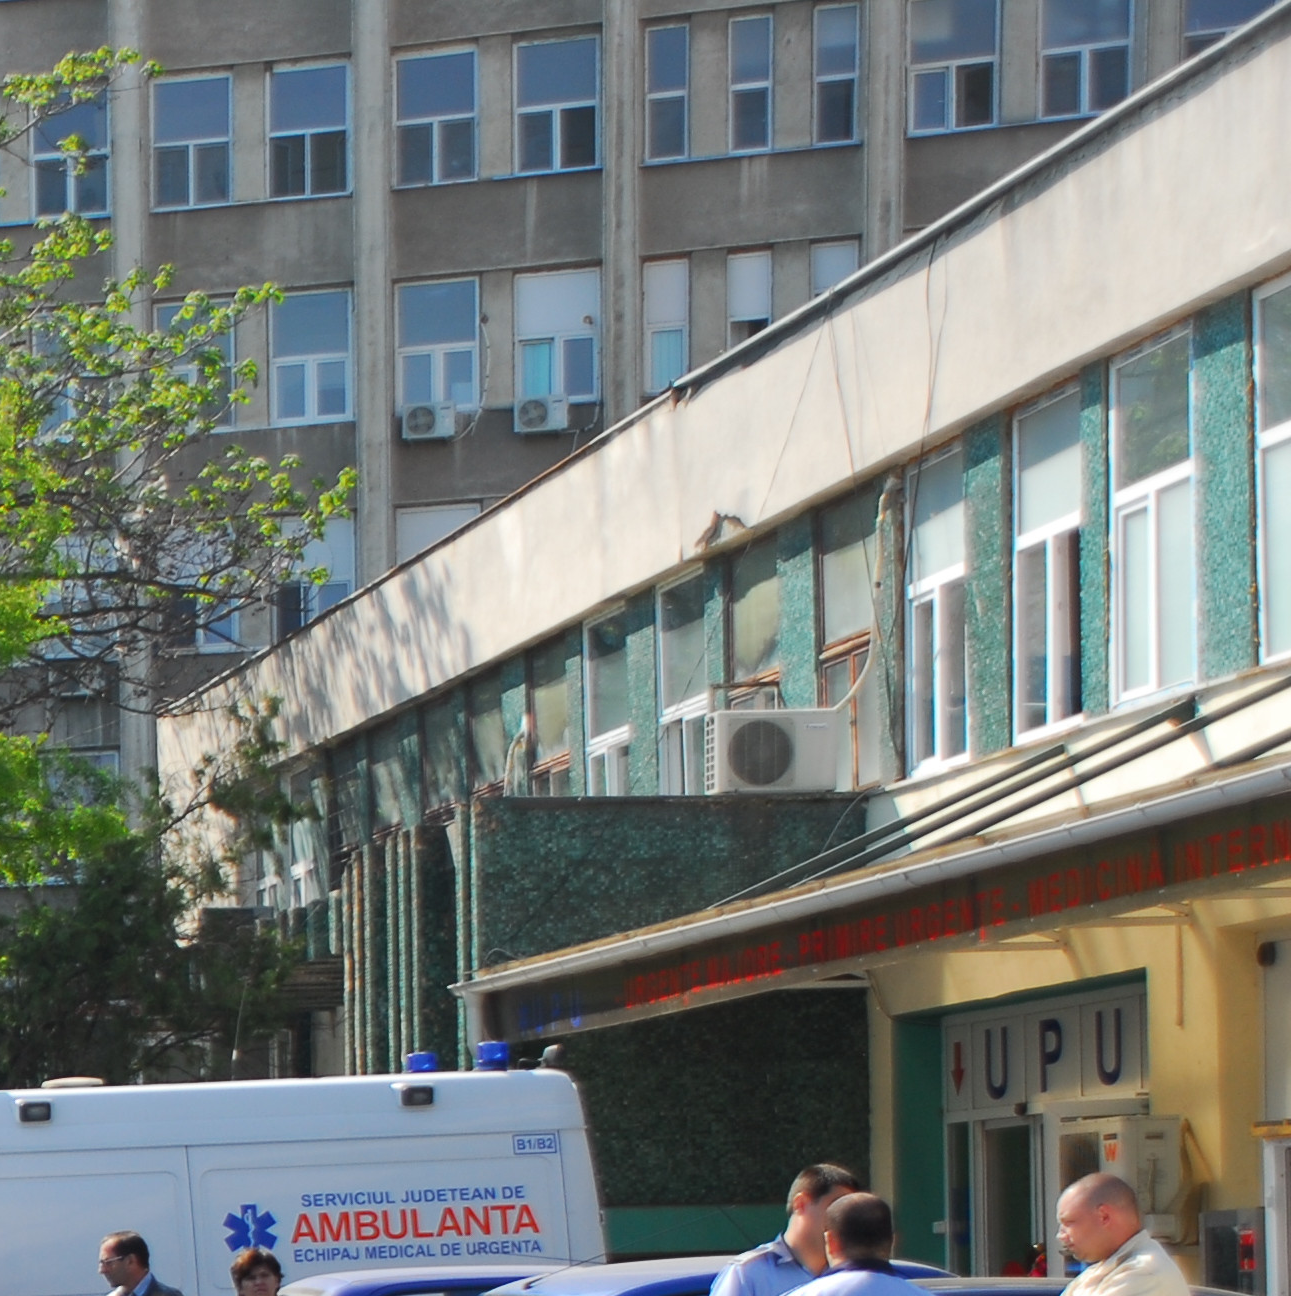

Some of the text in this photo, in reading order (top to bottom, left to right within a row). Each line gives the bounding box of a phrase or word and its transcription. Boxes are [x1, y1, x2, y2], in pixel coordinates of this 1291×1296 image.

[516, 1137, 554, 1150] B1/B2
[301, 1185, 525, 1207] SERVICIUL JUDETEAN DE
[291, 1204, 540, 1243] AMBULANTA
[294, 1240, 541, 1262] ECHIPAJ MEDICAL DE URGENTA
